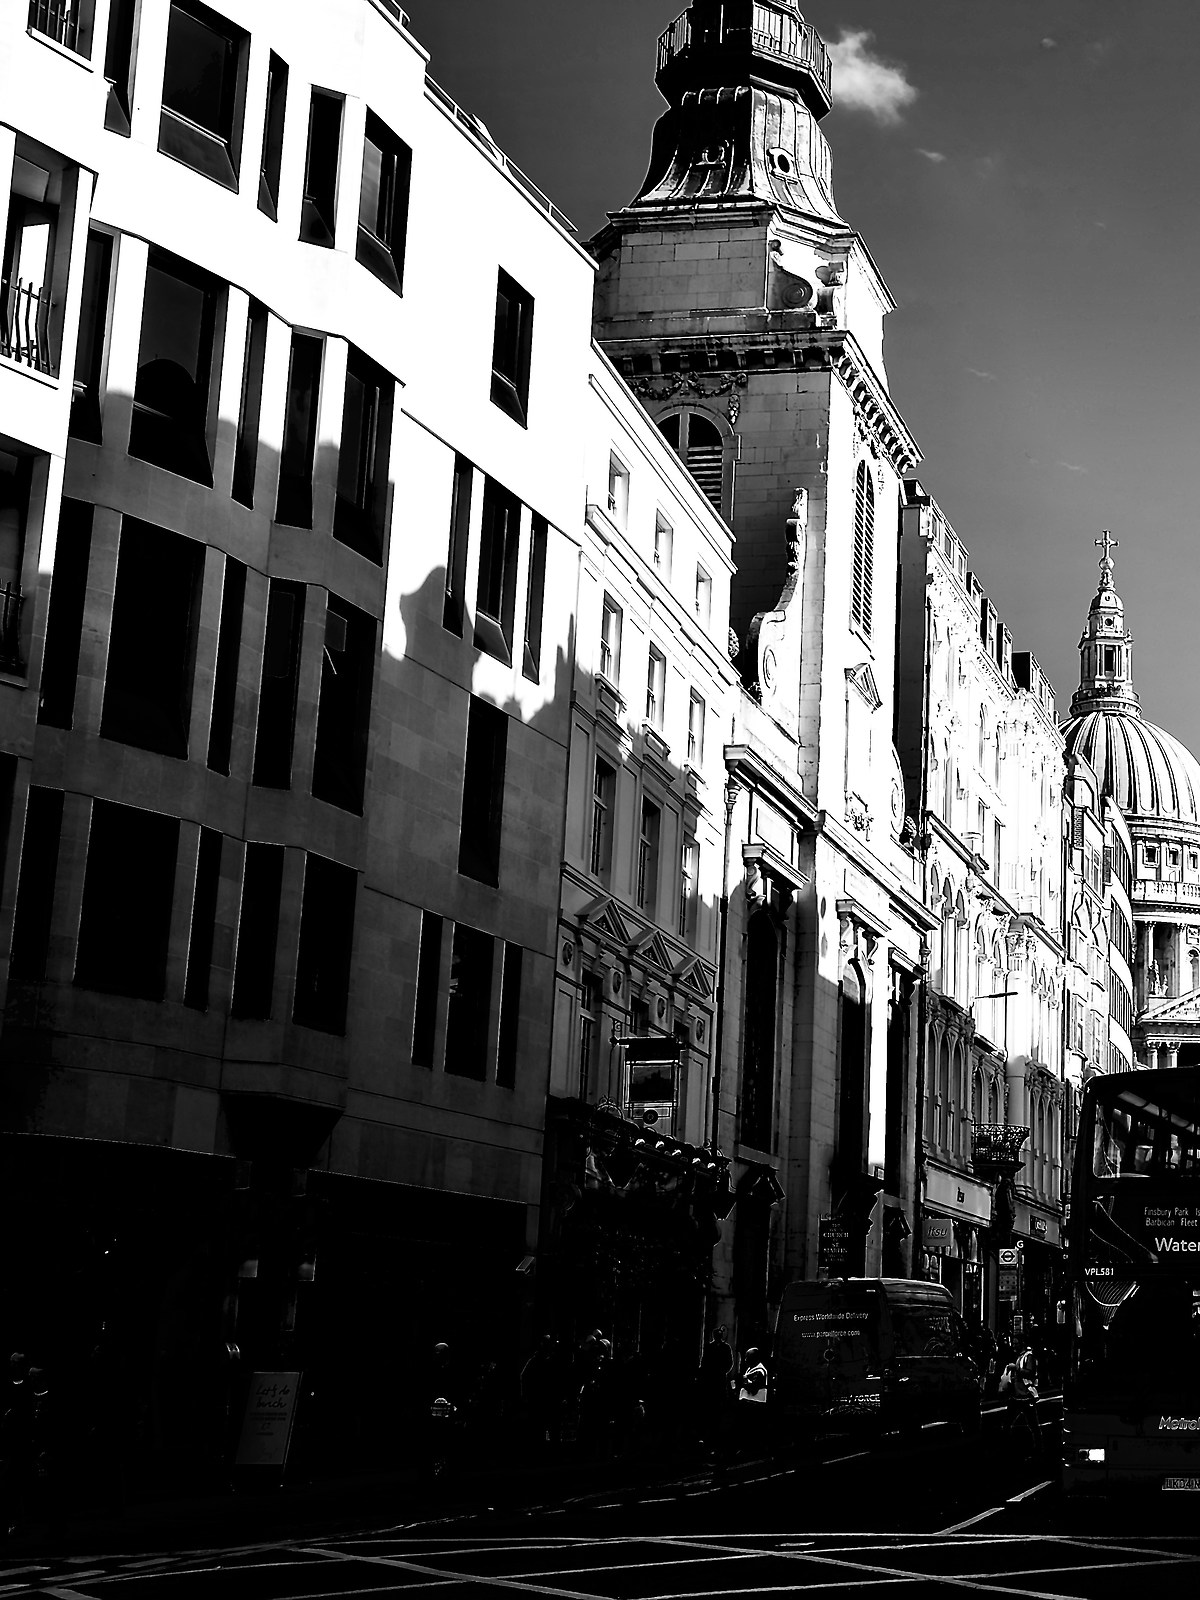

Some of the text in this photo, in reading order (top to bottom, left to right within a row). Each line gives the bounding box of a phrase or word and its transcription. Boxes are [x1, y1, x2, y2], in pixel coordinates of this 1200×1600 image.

[1144, 1206, 1189, 1218] Finsbury Park
[1145, 1218, 1175, 1227] Barbican
[1180, 1217, 1198, 1227] Fleet
[928, 1226, 947, 1237] itsu
[1016, 1240, 1024, 1248] G
[1084, 1267, 1114, 1276] VPL581
